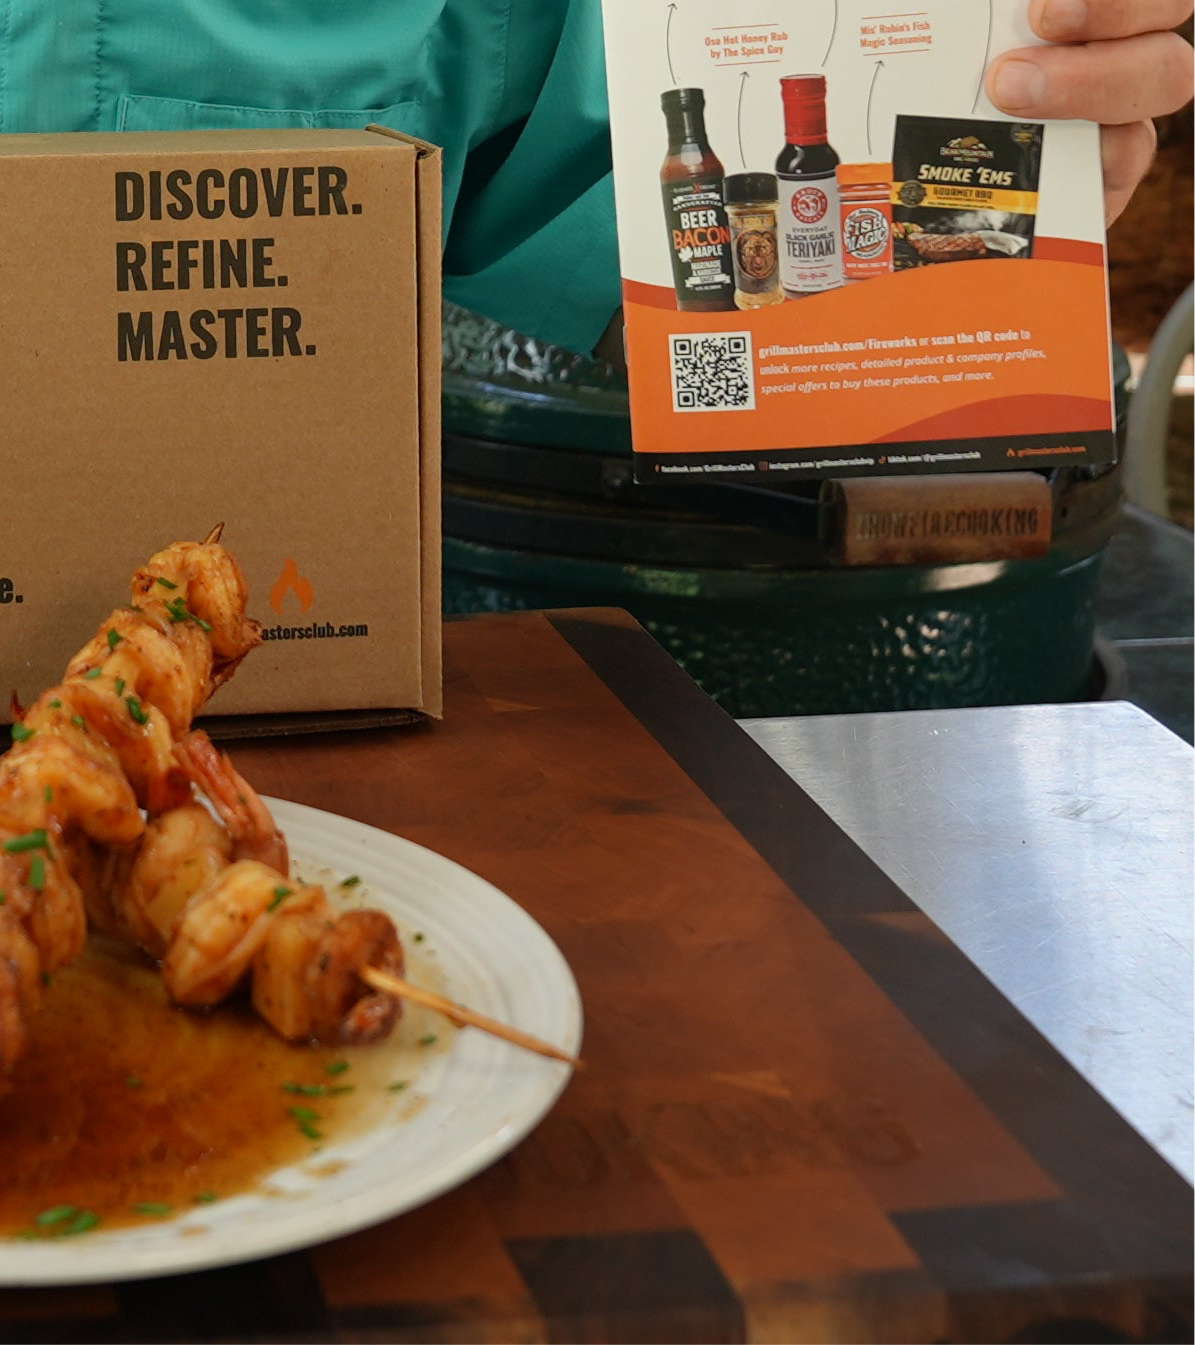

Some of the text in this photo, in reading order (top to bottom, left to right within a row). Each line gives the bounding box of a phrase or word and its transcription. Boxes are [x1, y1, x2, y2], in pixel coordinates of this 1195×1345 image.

[710, 49, 721, 59] by
[723, 48, 739, 57] The
[741, 46, 765, 57] Spice
[917, 164, 973, 183] SMOKE
[115, 166, 363, 221] DISCOVER.
[680, 209, 718, 229] BEER
[673, 226, 731, 250] BACON
[786, 239, 835, 258] TERIYAKI
[693, 244, 723, 258] MAPLE
[116, 237, 288, 292] REFINE.
[117, 307, 316, 362] MASTER.
[759, 336, 917, 359] grillmastersclub.com/Fireworks
[931, 336, 955, 346] scan
[957, 333, 974, 344] the
[976, 331, 992, 344] QR
[994, 330, 1019, 341] code
[1021, 330, 1031, 340] to
[760, 348, 1046, 375] unlock more recipes, detailed product & company profiles,
[761, 371, 995, 395] special offers to buy these products, and more.
[261, 622, 369, 641] astersclub.com
